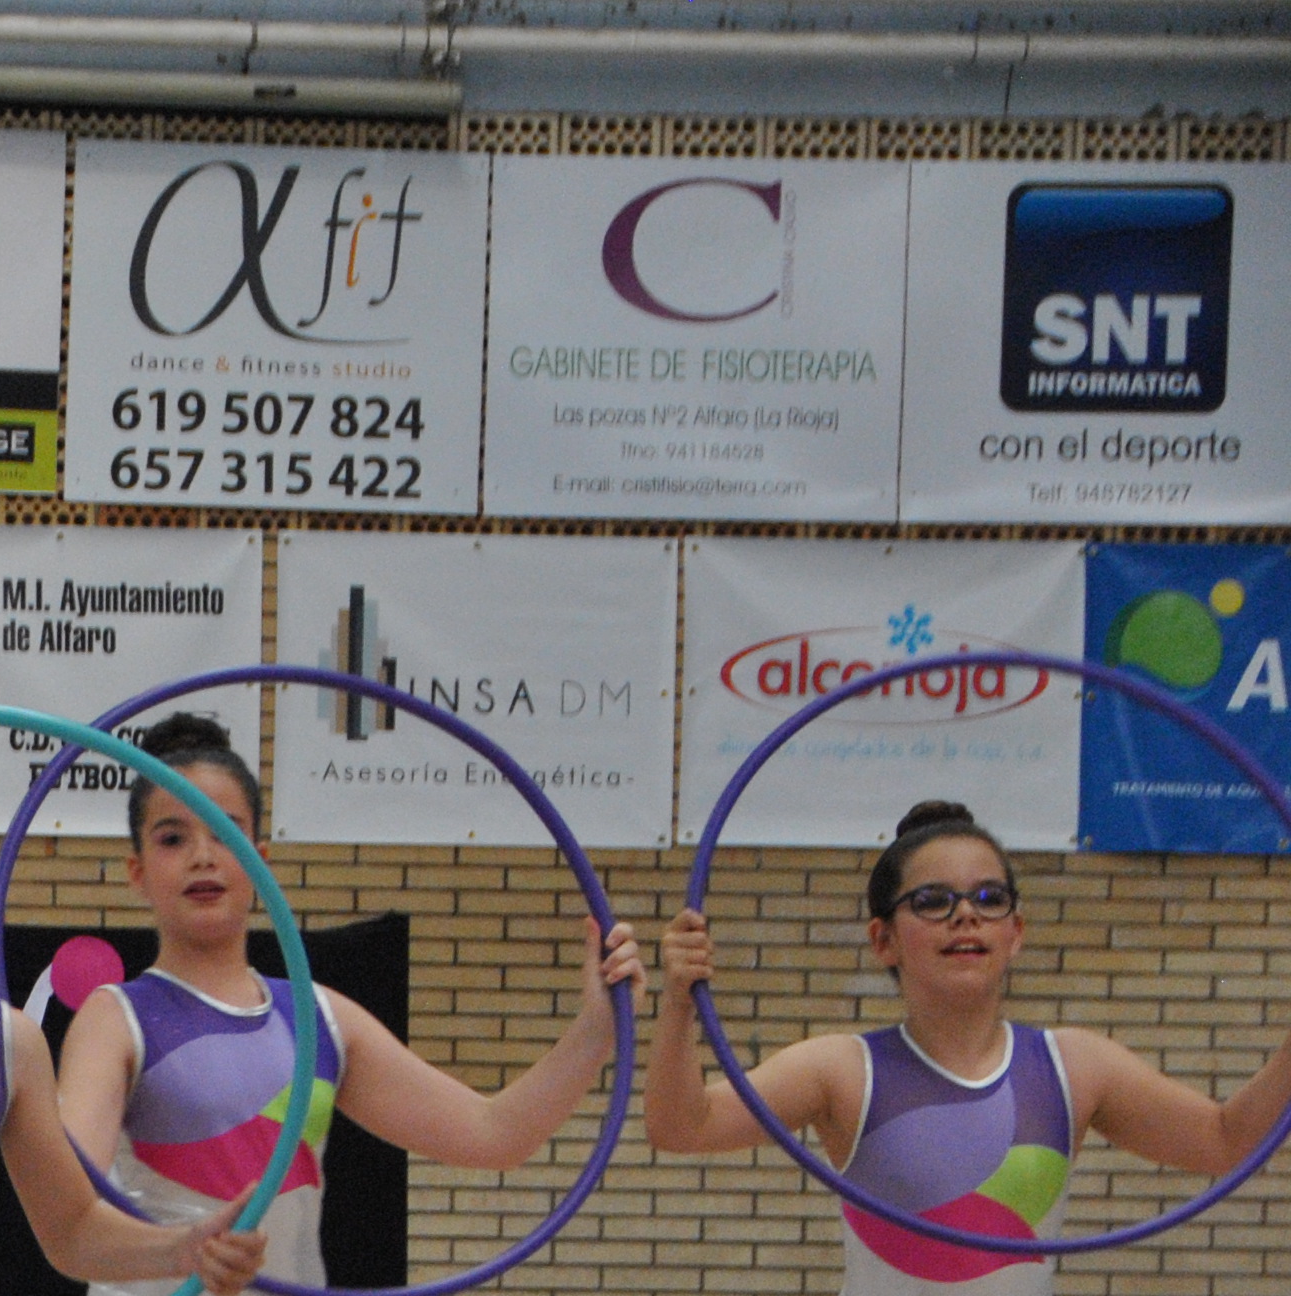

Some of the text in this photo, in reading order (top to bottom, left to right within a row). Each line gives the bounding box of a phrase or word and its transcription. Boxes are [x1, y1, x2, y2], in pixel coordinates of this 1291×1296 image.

[1030, 293, 1203, 366] SNT
[130, 352, 412, 379] dance & fitness studio
[510, 345, 640, 380] GABINETE
[651, 350, 688, 381] DE
[112, 388, 425, 440] 619 507 824
[979, 429, 1241, 467] con el deporte
[110, 447, 422, 498] 657 315 422
[2, 578, 225, 619] M.I. Ayuntamiento
[2, 620, 117, 654] de Alfaro
[29, 760, 133, 792] FTBOL
[465, 763, 635, 790] Enegética-
